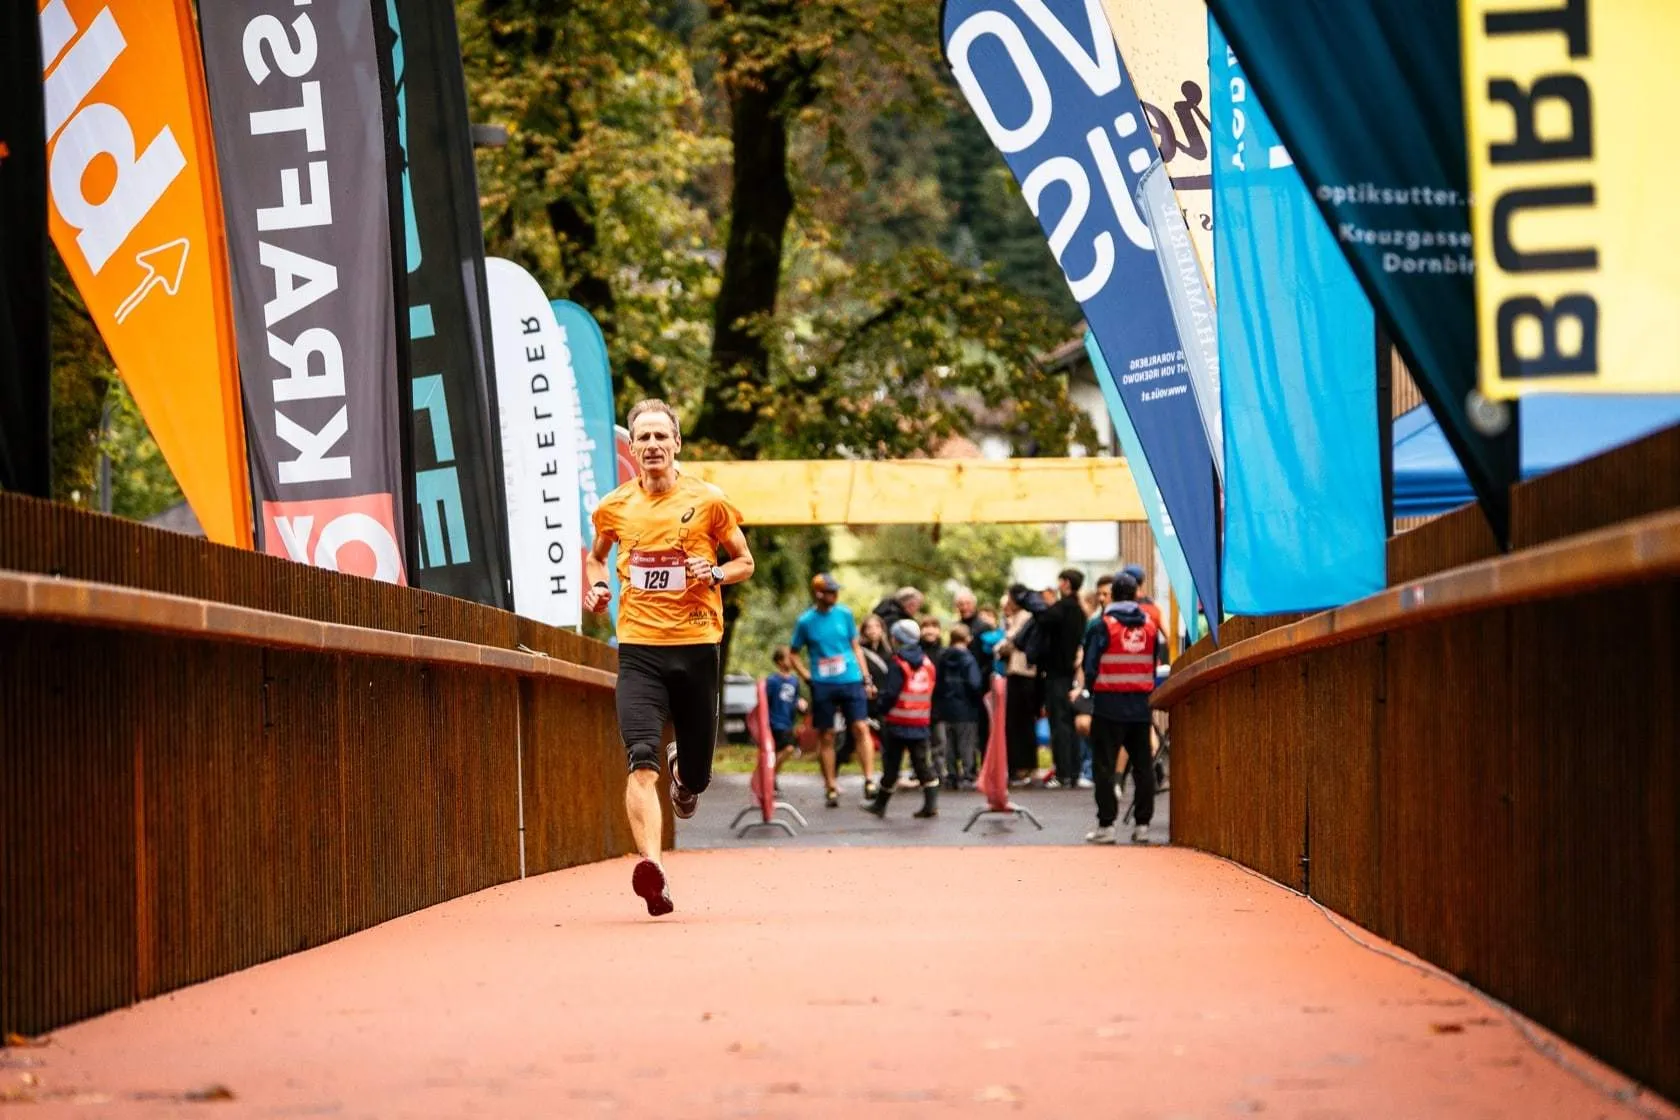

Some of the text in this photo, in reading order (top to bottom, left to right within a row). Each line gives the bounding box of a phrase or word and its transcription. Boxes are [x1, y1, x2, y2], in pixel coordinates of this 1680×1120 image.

[1316, 181, 1476, 207] optiksutter.
[1338, 223, 1473, 251] Kreuzgasse
[1382, 252, 1476, 275] Dornbir
[644, 570, 670, 589] 129
